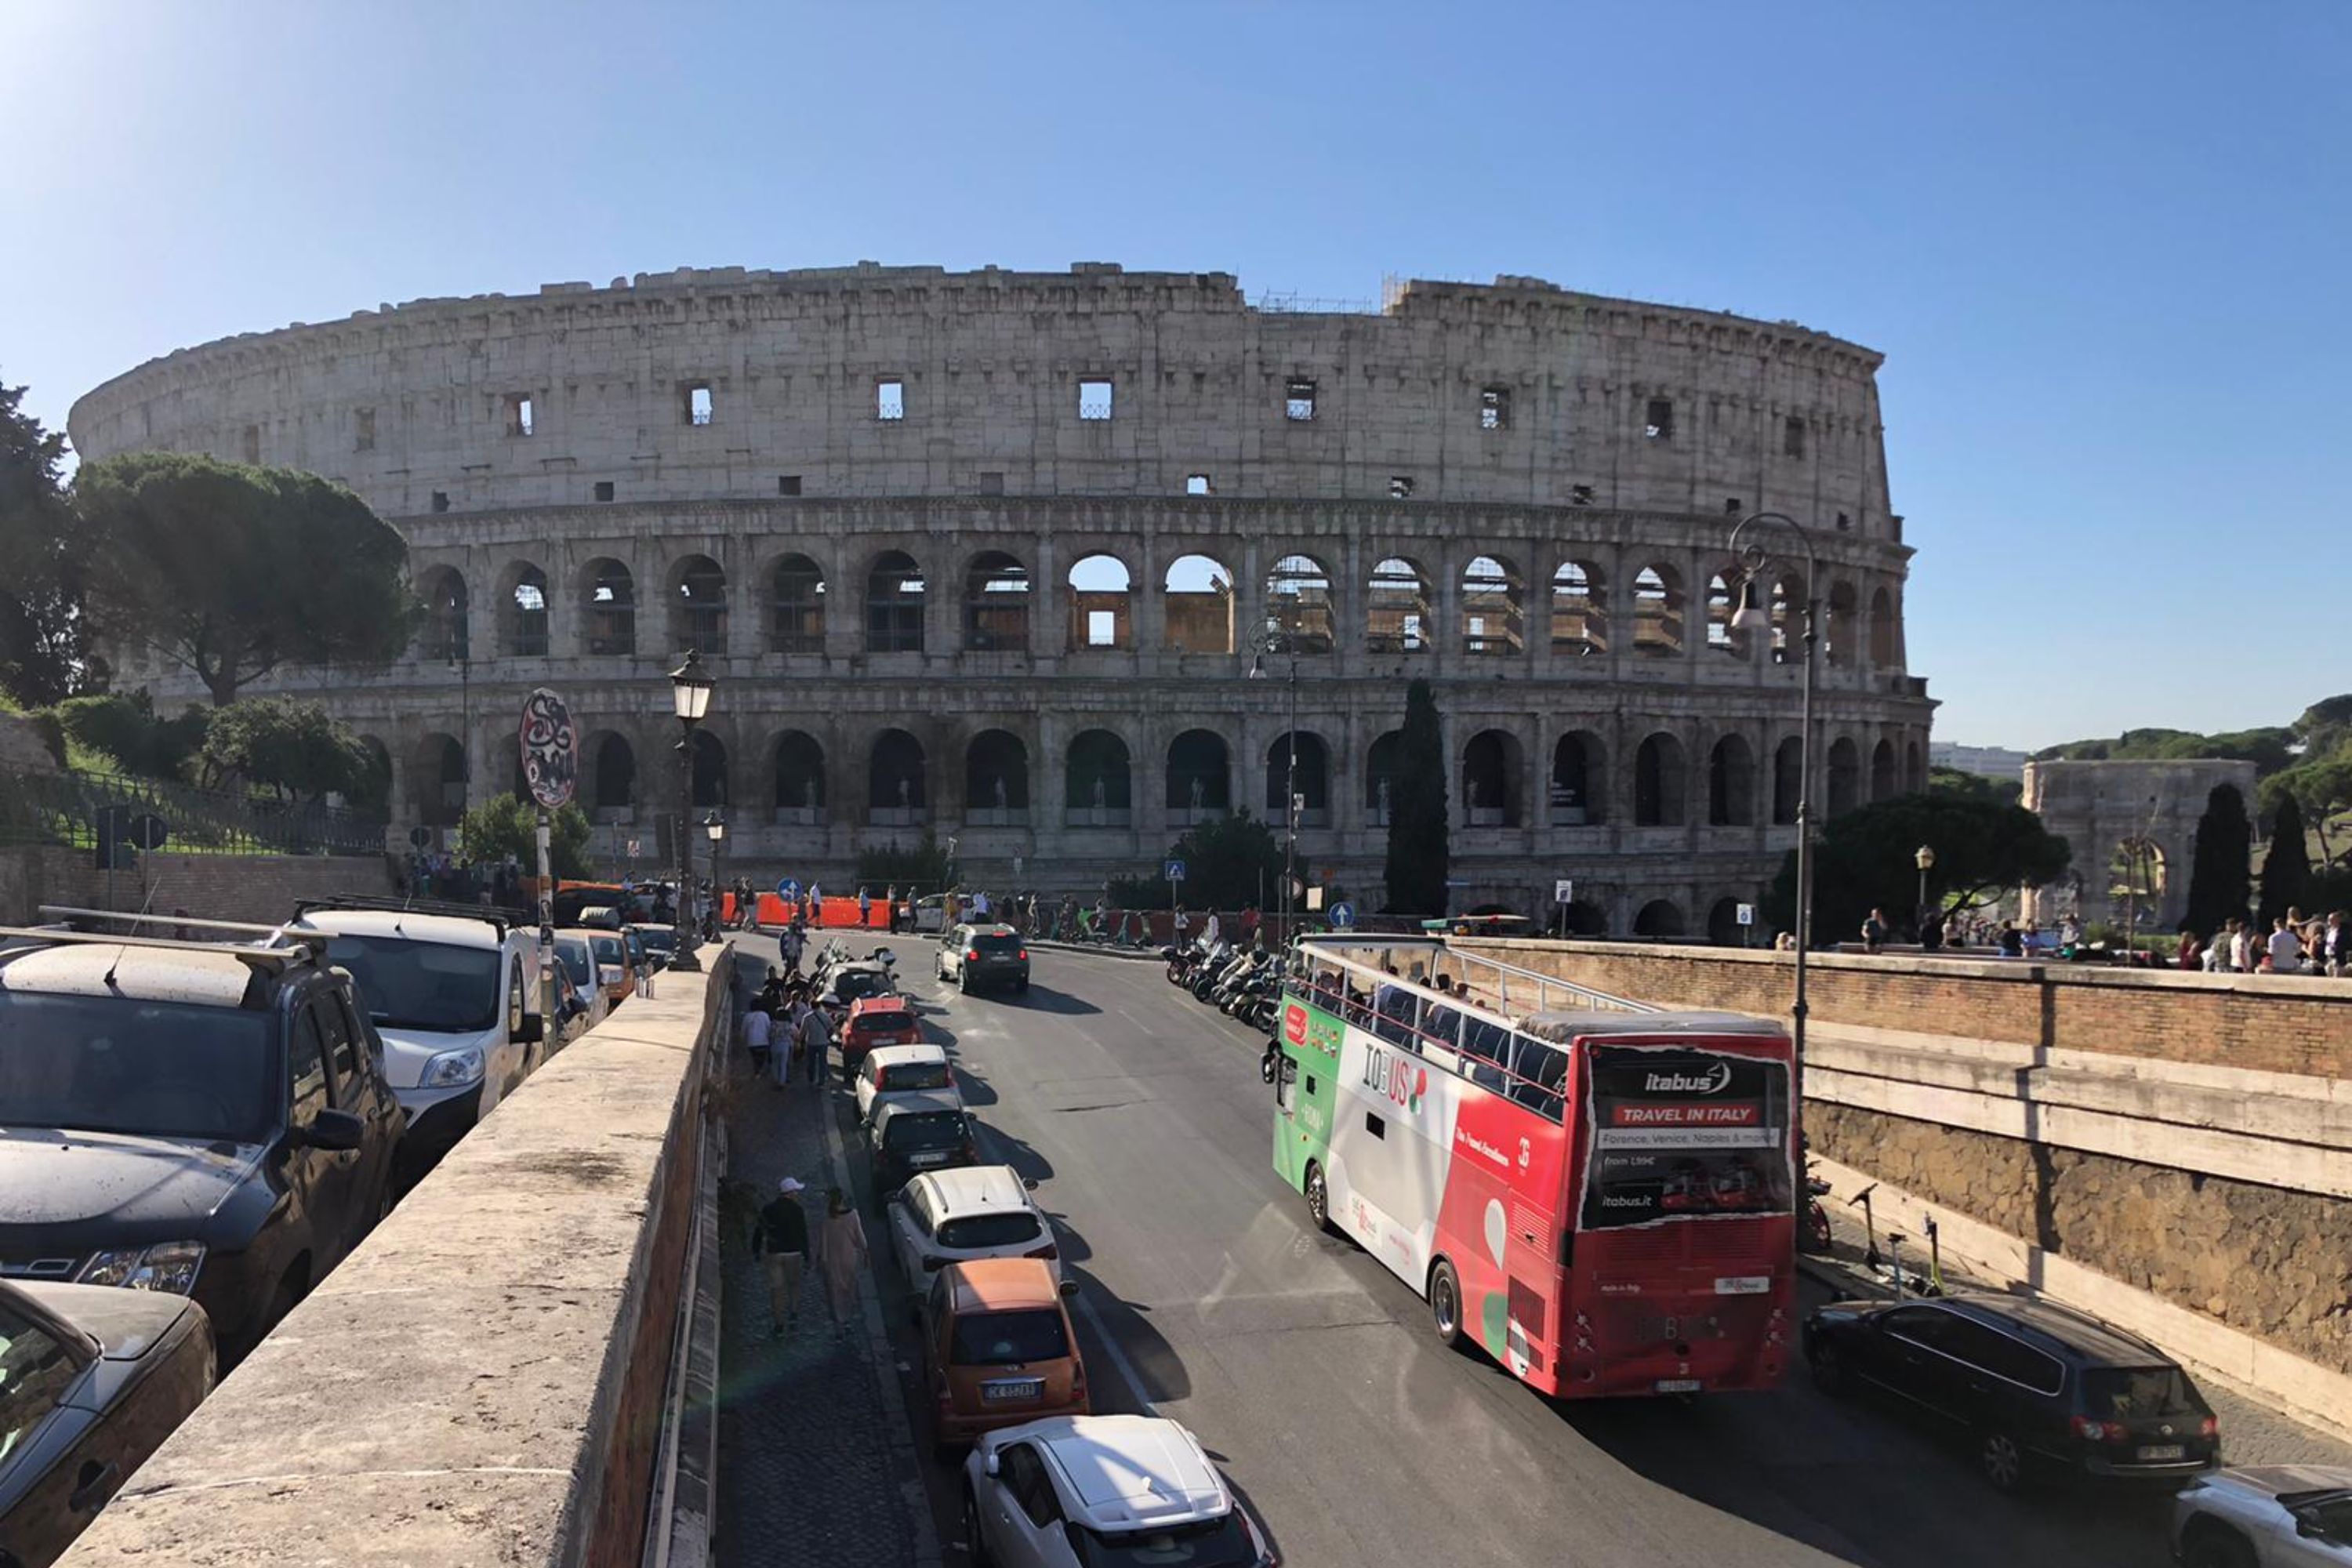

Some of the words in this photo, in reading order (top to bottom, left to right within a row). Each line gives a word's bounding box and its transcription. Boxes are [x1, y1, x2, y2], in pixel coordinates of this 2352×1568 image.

[1645, 1073, 1712, 1091] itabus
[1624, 1108, 1682, 1122] TRAVEL
[1686, 1108, 1704, 1121] IN
[1707, 1108, 1751, 1121] ITALY
